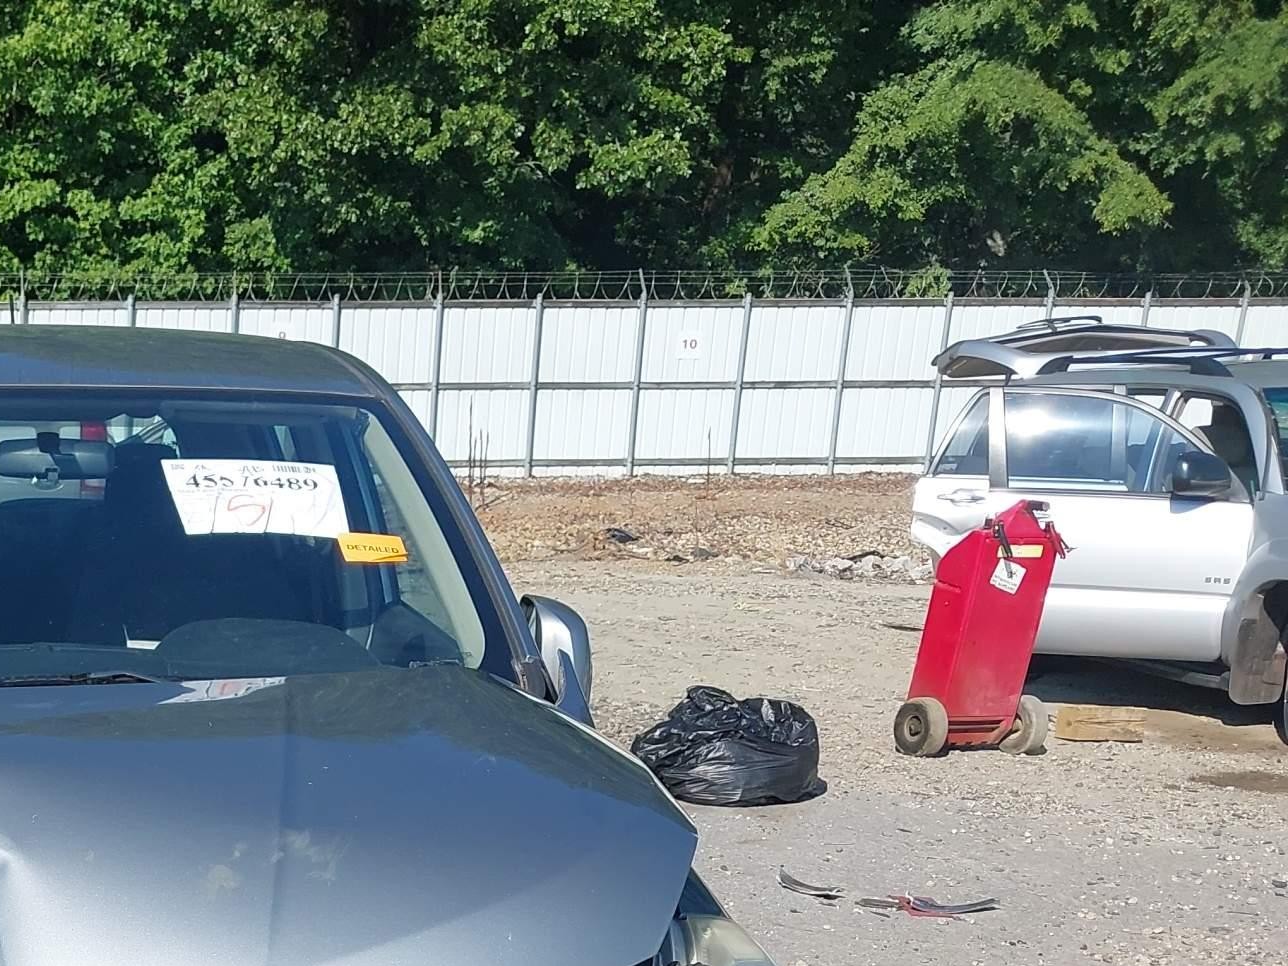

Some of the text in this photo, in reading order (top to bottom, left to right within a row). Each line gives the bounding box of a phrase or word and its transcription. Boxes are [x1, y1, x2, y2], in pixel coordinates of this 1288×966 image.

[682, 339, 698, 350] 10
[185, 474, 319, 491] 45576489
[346, 544, 400, 554] DETAILED
